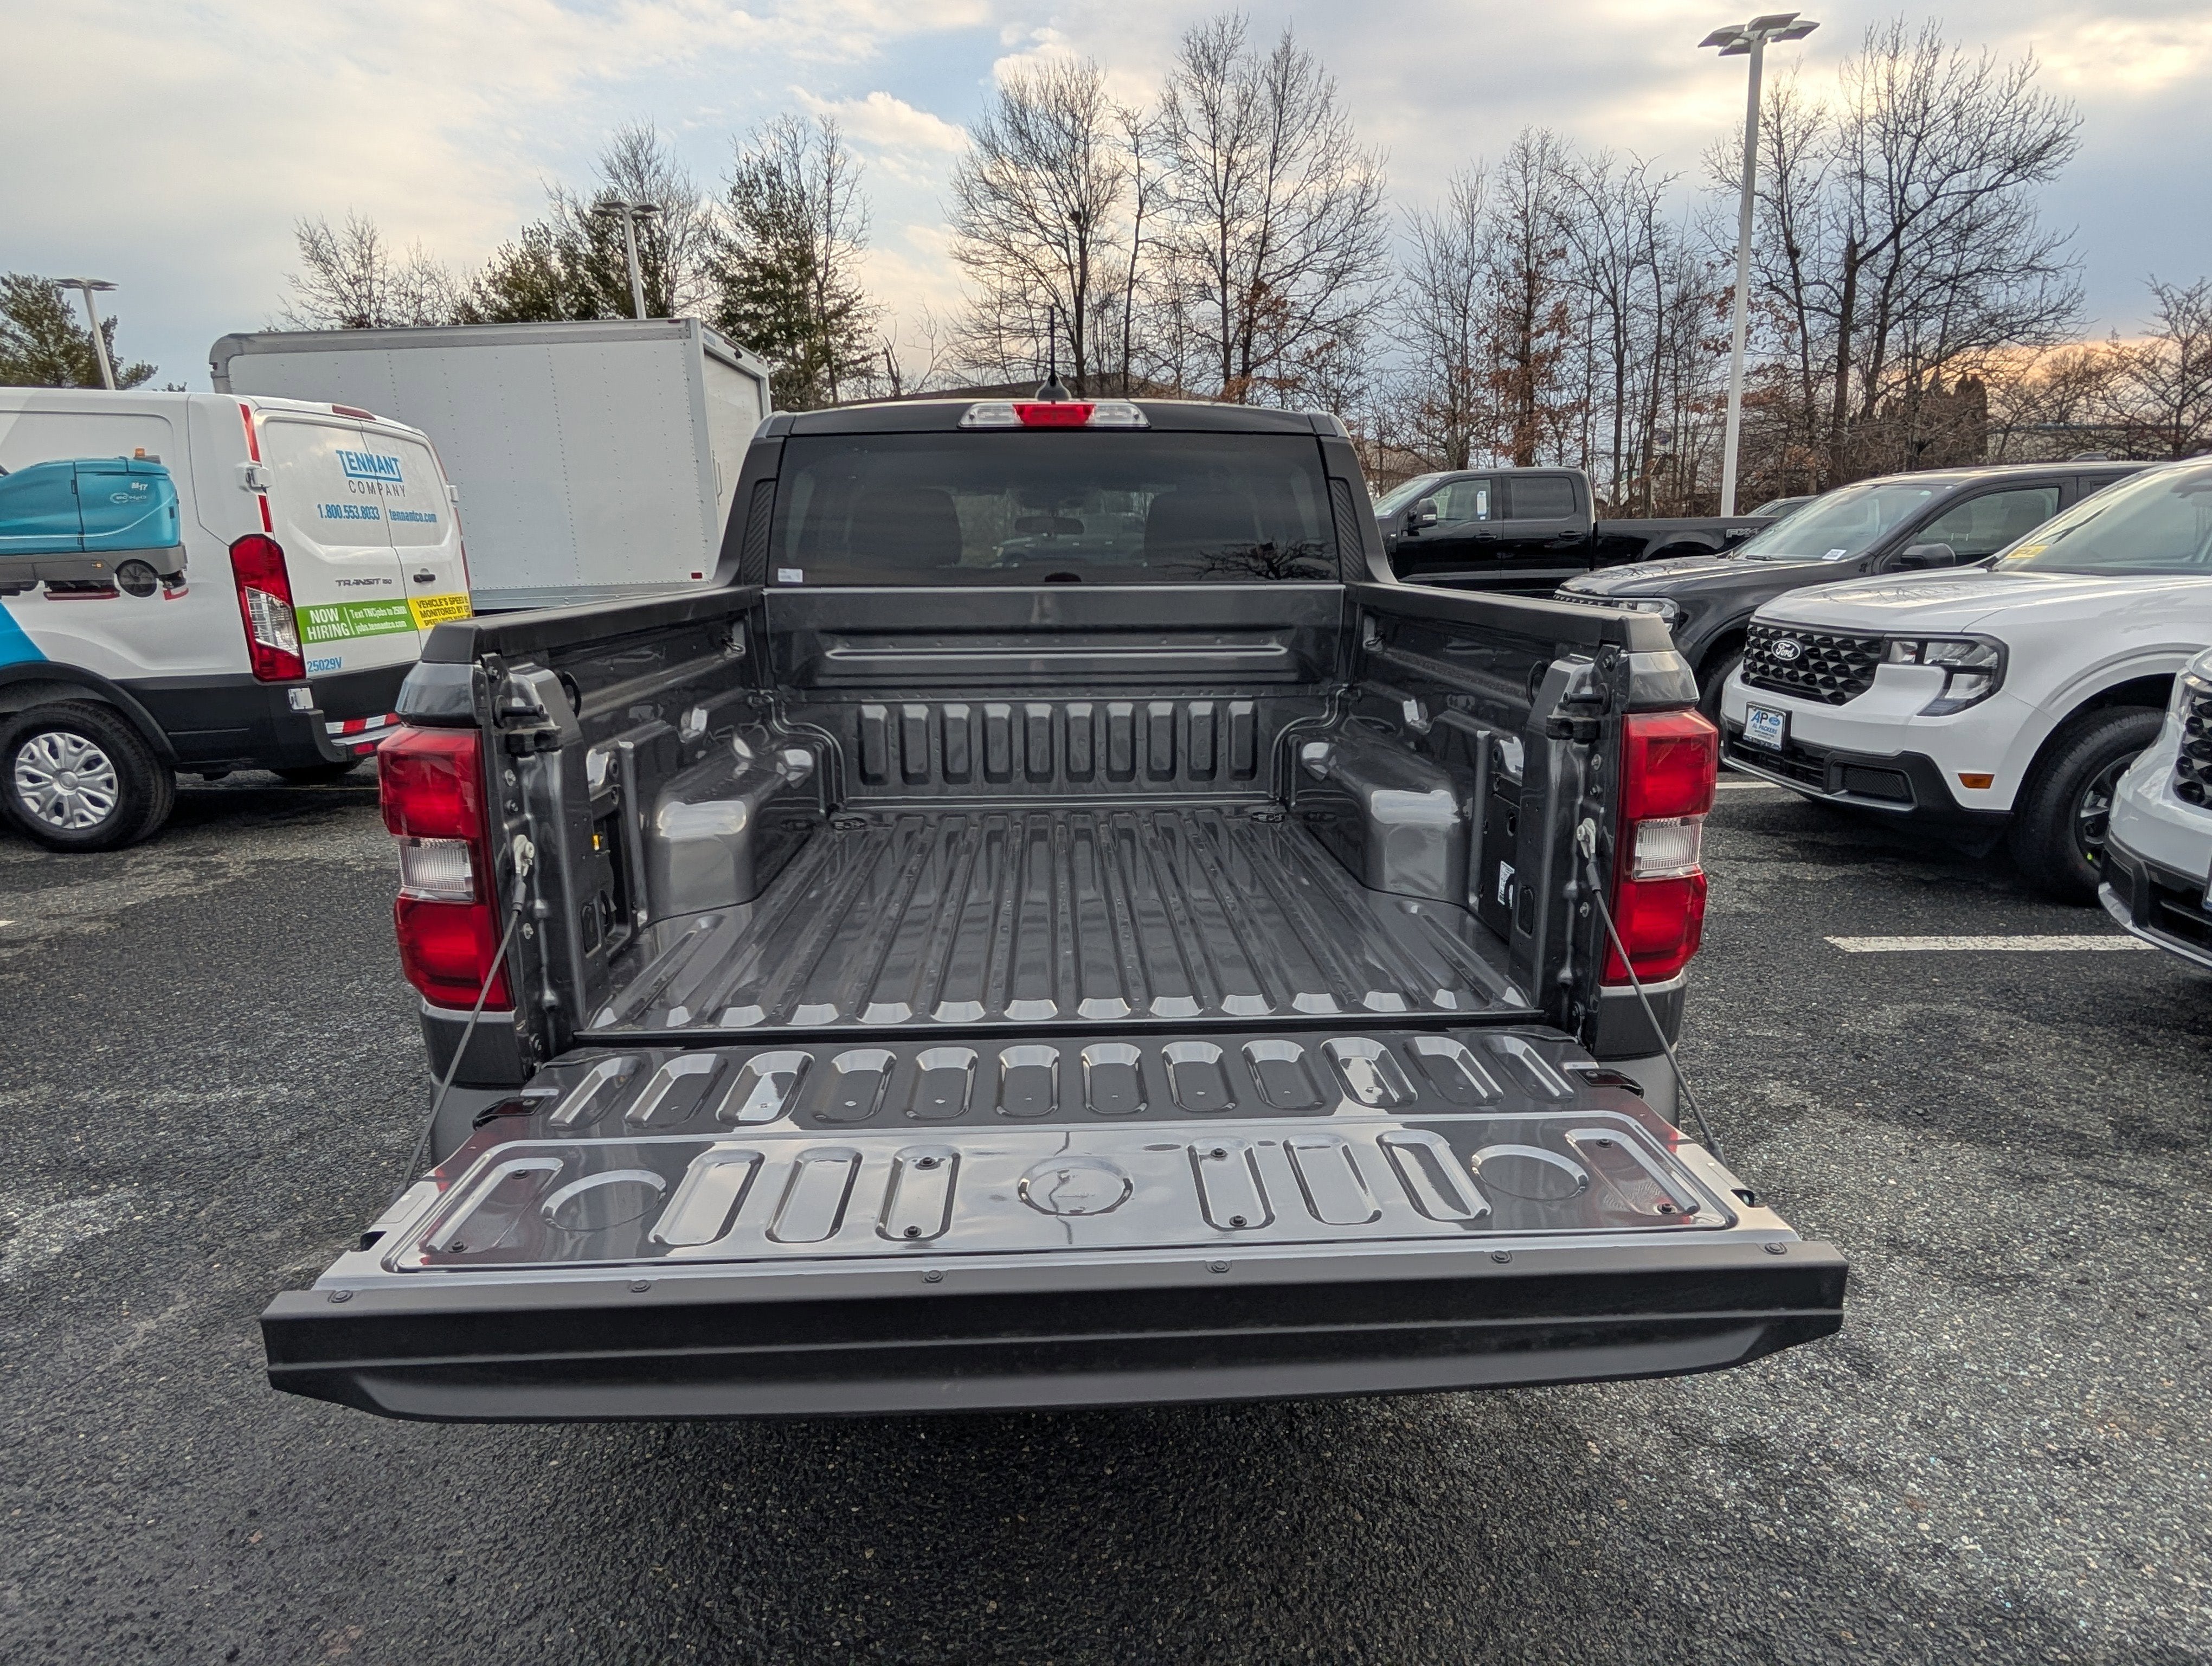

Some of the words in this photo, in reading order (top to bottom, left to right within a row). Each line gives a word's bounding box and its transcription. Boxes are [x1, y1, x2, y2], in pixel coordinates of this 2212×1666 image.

[336, 450, 403, 482] TENNANT
[348, 480, 406, 497] COMPANY
[318, 503, 380, 520] 1.800.553.8033
[389, 509, 436, 522] tennantco.com
[335, 578, 381, 587] TRANSIT
[416, 598, 449, 608] VEHICLE'S
[448, 596, 465, 605] SPEED
[309, 607, 339, 624] NOW
[349, 609, 365, 619] Text
[387, 607, 394, 616] to
[419, 607, 456, 619] MONITORED
[456, 605, 464, 614] BY
[307, 623, 350, 640] HIRING
[354, 620, 407, 635] jobs.tennantco.com
[1776, 642, 1795, 658] Ford
[307, 657, 342, 672] 25029V
[1751, 710, 1769, 724] AP
